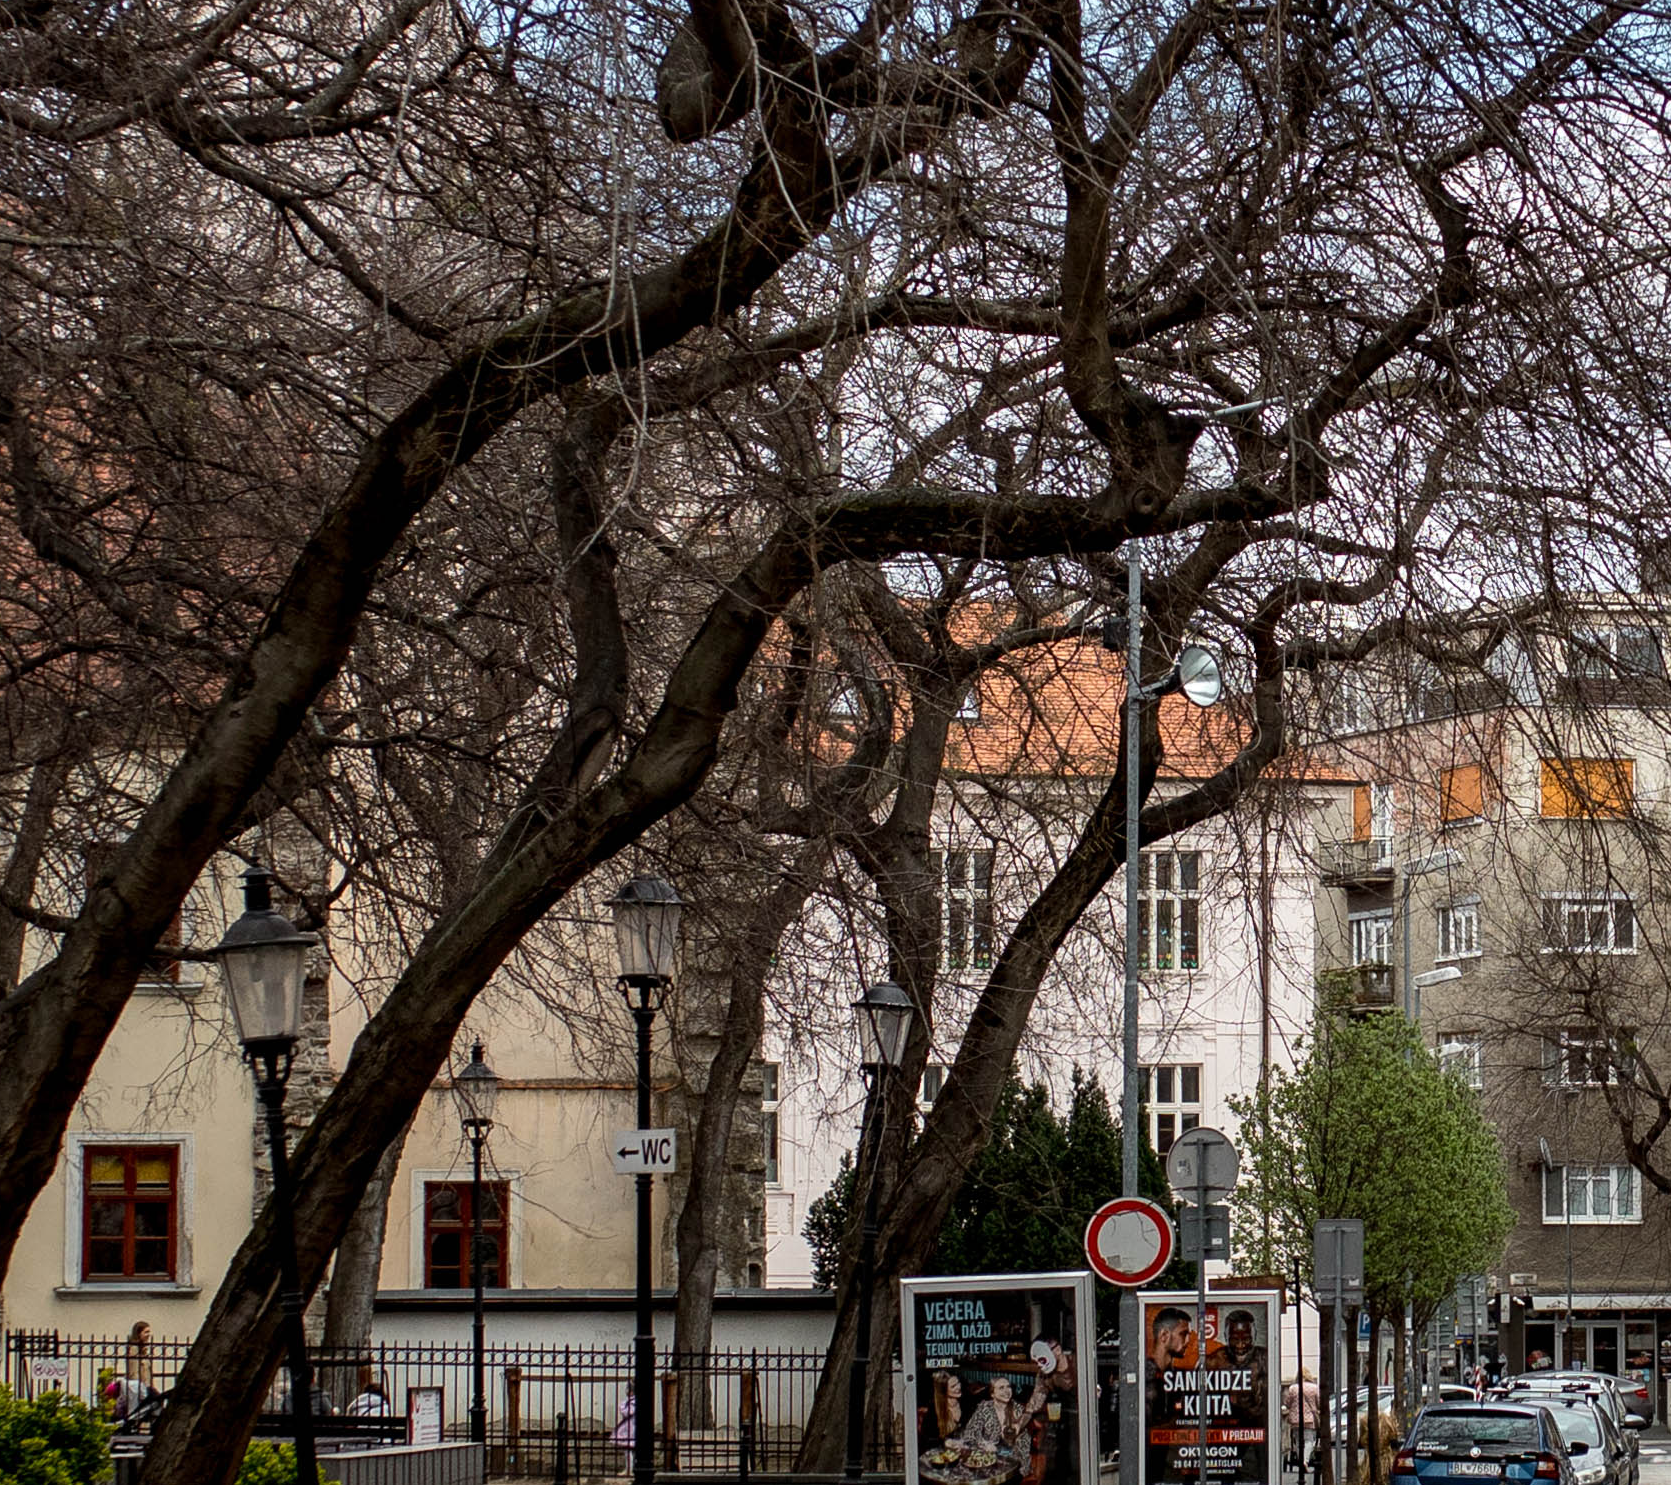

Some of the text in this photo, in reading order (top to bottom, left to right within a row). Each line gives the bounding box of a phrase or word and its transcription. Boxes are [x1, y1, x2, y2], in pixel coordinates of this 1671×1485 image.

[641, 1137, 671, 1165] WC
[924, 1298, 985, 1322] VEČERA
[1362, 1313, 1370, 1331] P
[925, 1323, 959, 1341] ZIMA,
[925, 1341, 1009, 1356] TEQUILY, LETENKY
